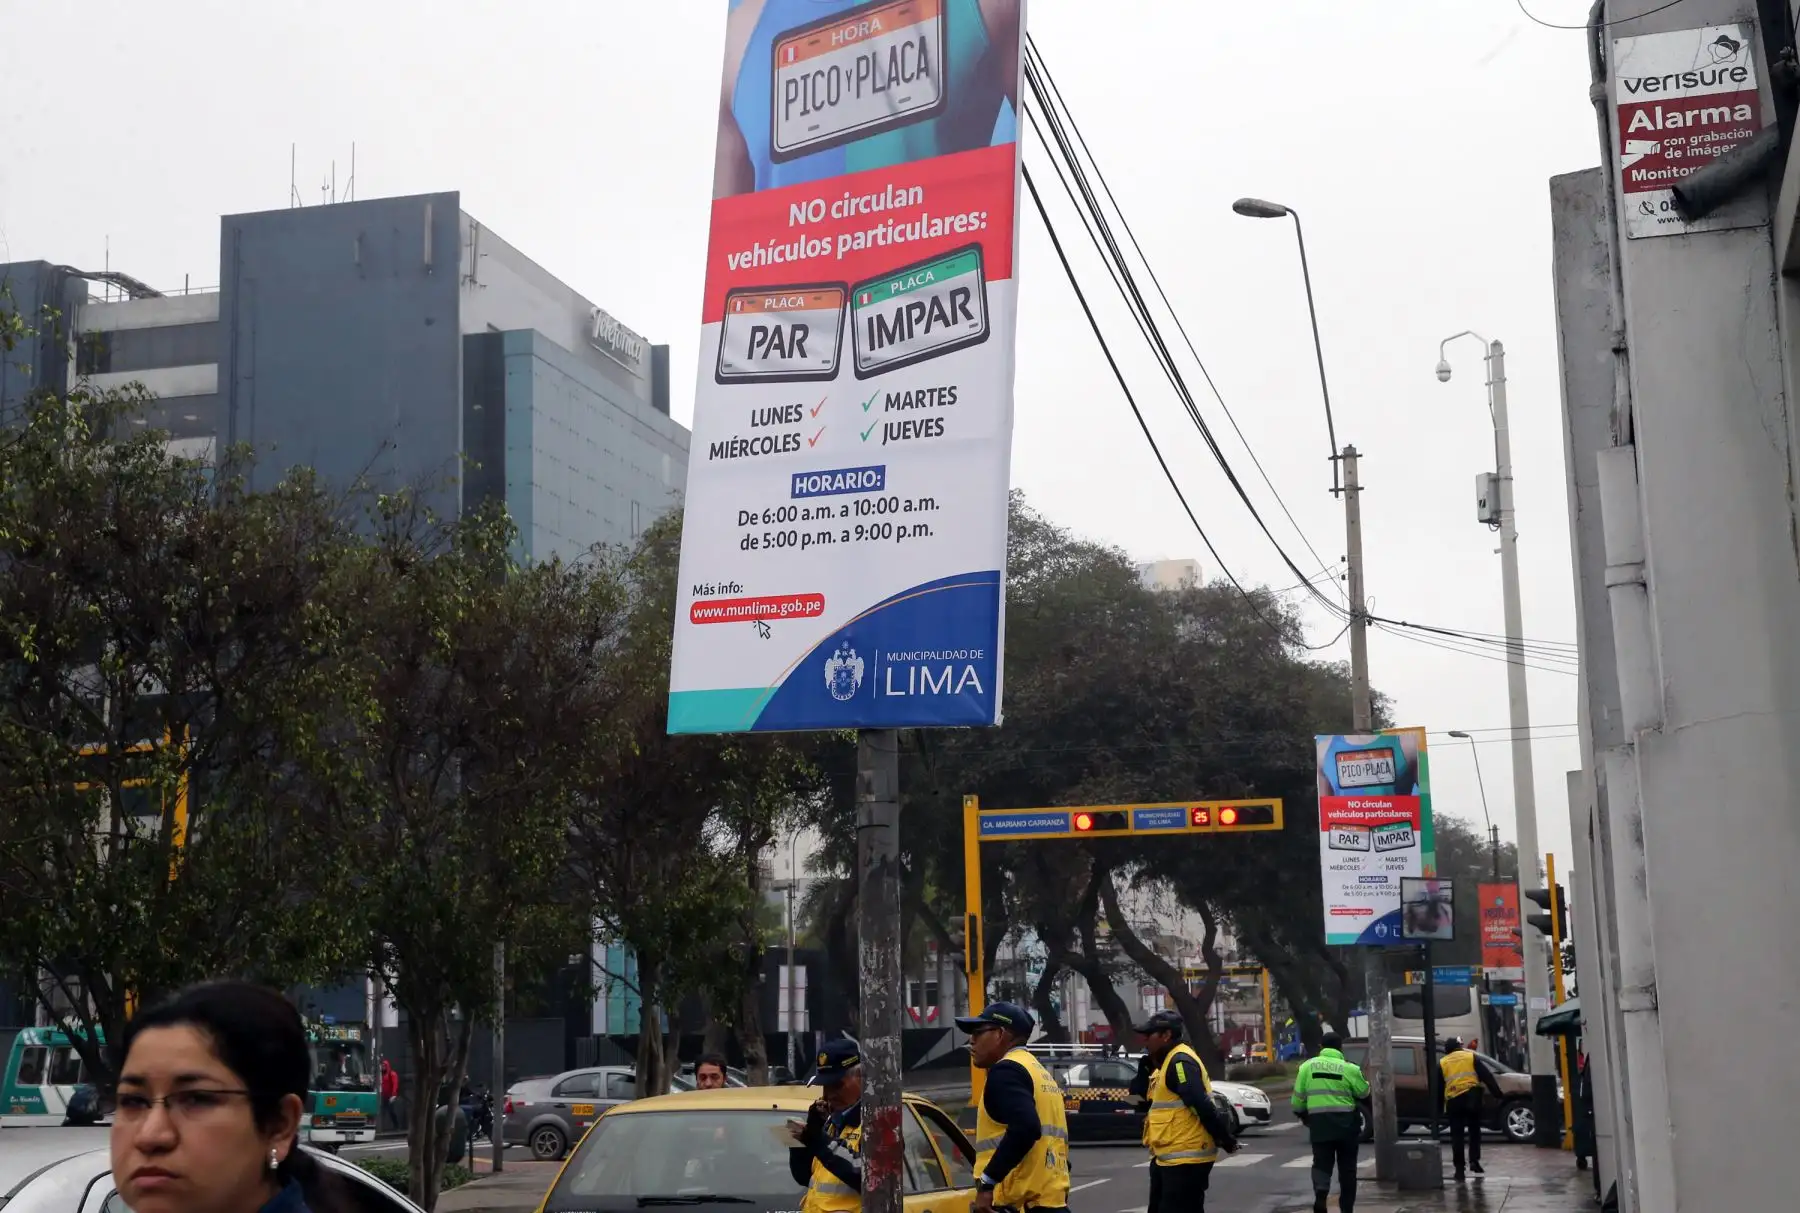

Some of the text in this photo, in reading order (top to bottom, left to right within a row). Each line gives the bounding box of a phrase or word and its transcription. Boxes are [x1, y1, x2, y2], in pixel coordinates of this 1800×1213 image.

[831, 17, 883, 46] HORA
[784, 35, 930, 121] PICO Y PLACA
[1623, 66, 1749, 94] verisure
[1627, 103, 1752, 133] Alarma
[1663, 128, 1753, 147] con grabación
[1664, 148, 1682, 159] de
[789, 184, 923, 227] NO circulan
[728, 210, 988, 271] vehículos particulares:
[890, 270, 935, 294] PLACA
[764, 296, 805, 309] PLACA
[867, 286, 975, 352] IMPAR
[747, 323, 809, 361] PAR
[884, 386, 957, 412] MARTES
[750, 403, 804, 428] LUNES
[882, 417, 945, 446] JUEVES
[709, 432, 801, 461] MIÉRCOLES
[795, 471, 882, 495] HORARIO:
[738, 497, 940, 526] De 6:00 a.m. a 10:00 a.m.
[740, 523, 934, 551] de 5:00 p.m. a 9:00 p.m.
[692, 581, 744, 597] Más info:
[693, 599, 821, 620] www.munlima.gob.pe
[887, 650, 984, 661] MUNICIPALIDAD DE
[885, 664, 984, 697] LIMA
[1341, 764, 1362, 778] PICO
[1365, 761, 1392, 776] PLACA
[1361, 800, 1392, 808] circulan
[996, 820, 1027, 828] MARIANO
[1028, 818, 1065, 827] CARRANZA
[1194, 811, 1208, 823] 25
[1338, 834, 1360, 845] PAR
[1377, 832, 1411, 846] IMPAR
